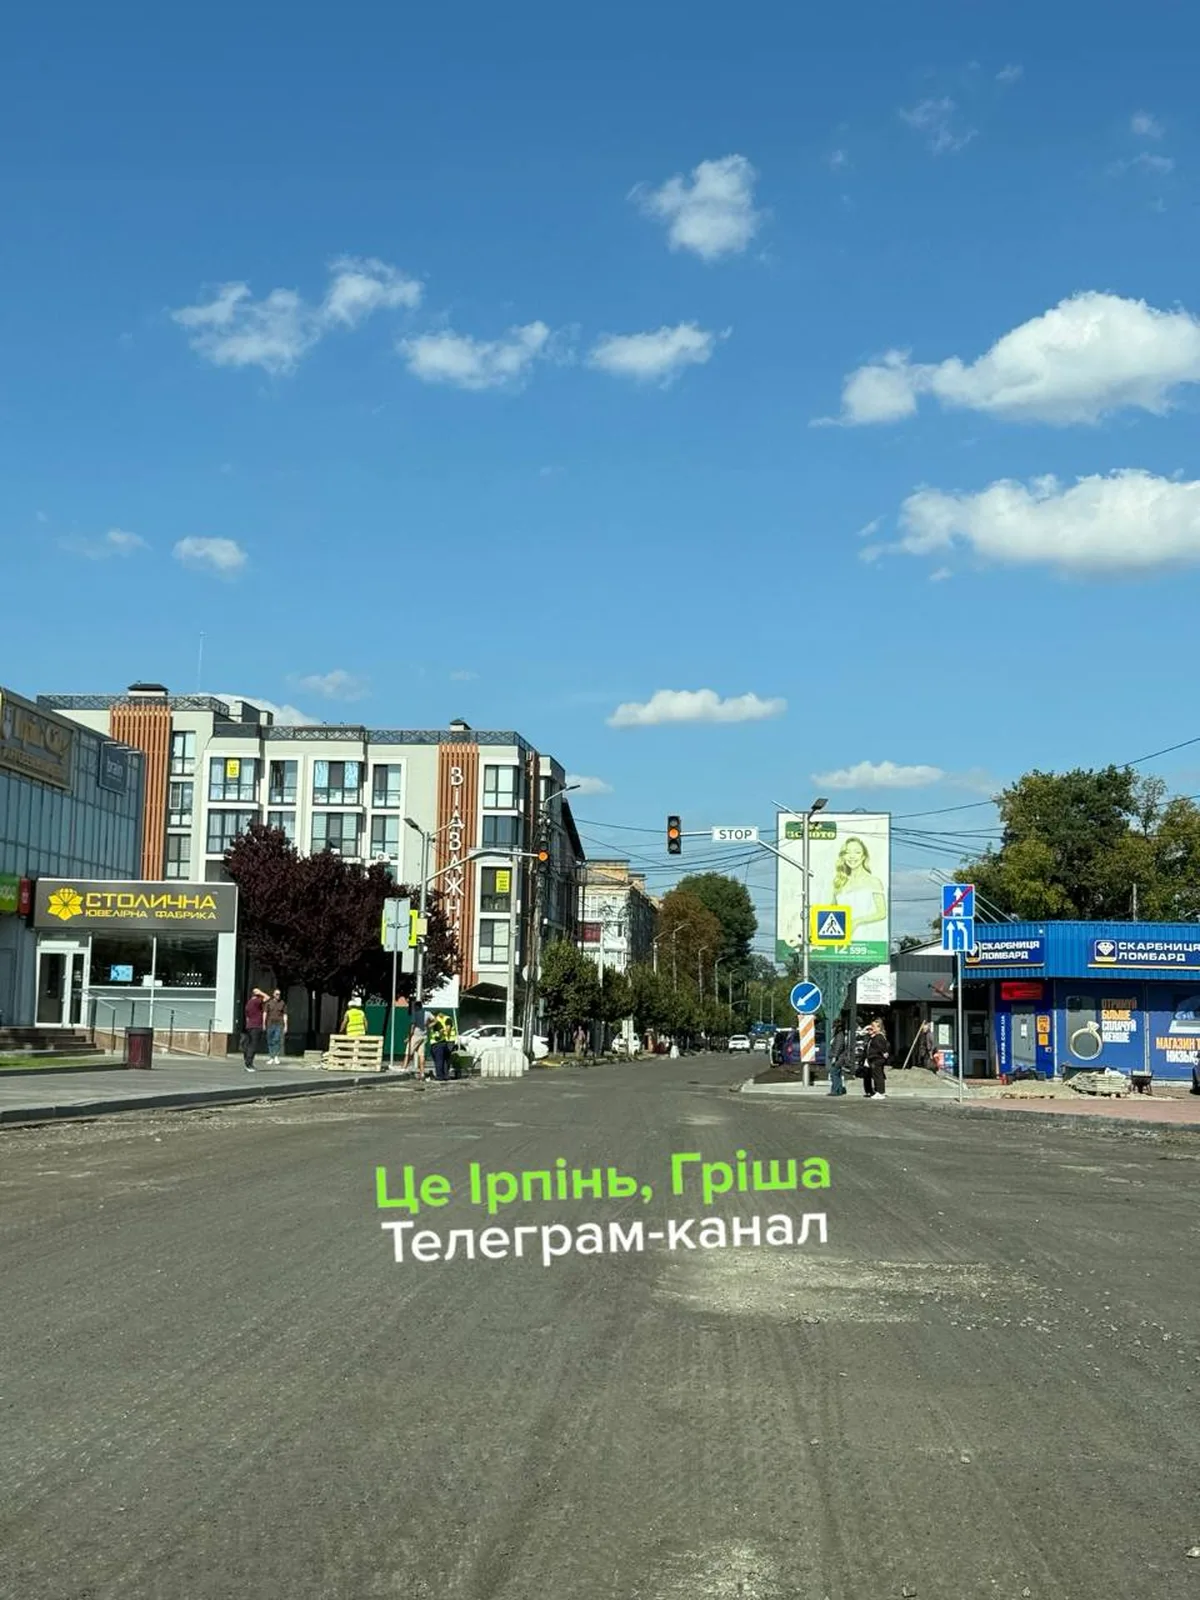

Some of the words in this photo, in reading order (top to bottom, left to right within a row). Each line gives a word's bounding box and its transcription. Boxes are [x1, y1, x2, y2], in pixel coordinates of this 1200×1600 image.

[719, 829, 752, 840] STOP
[85, 892, 218, 910] СТОЛИЧНА
[85, 908, 148, 918] ЮВЕЛІРНА
[155, 910, 217, 920] ФАБРИКА
[981, 940, 1040, 950] СКАРБНИЦЯ
[1118, 941, 1200, 952] СКАРБНИЦЯ
[981, 950, 1028, 961] ЛОМБАРД
[1118, 952, 1187, 963] ЛОМБАРД
[1156, 1036, 1195, 1050] МАГАЗИН
